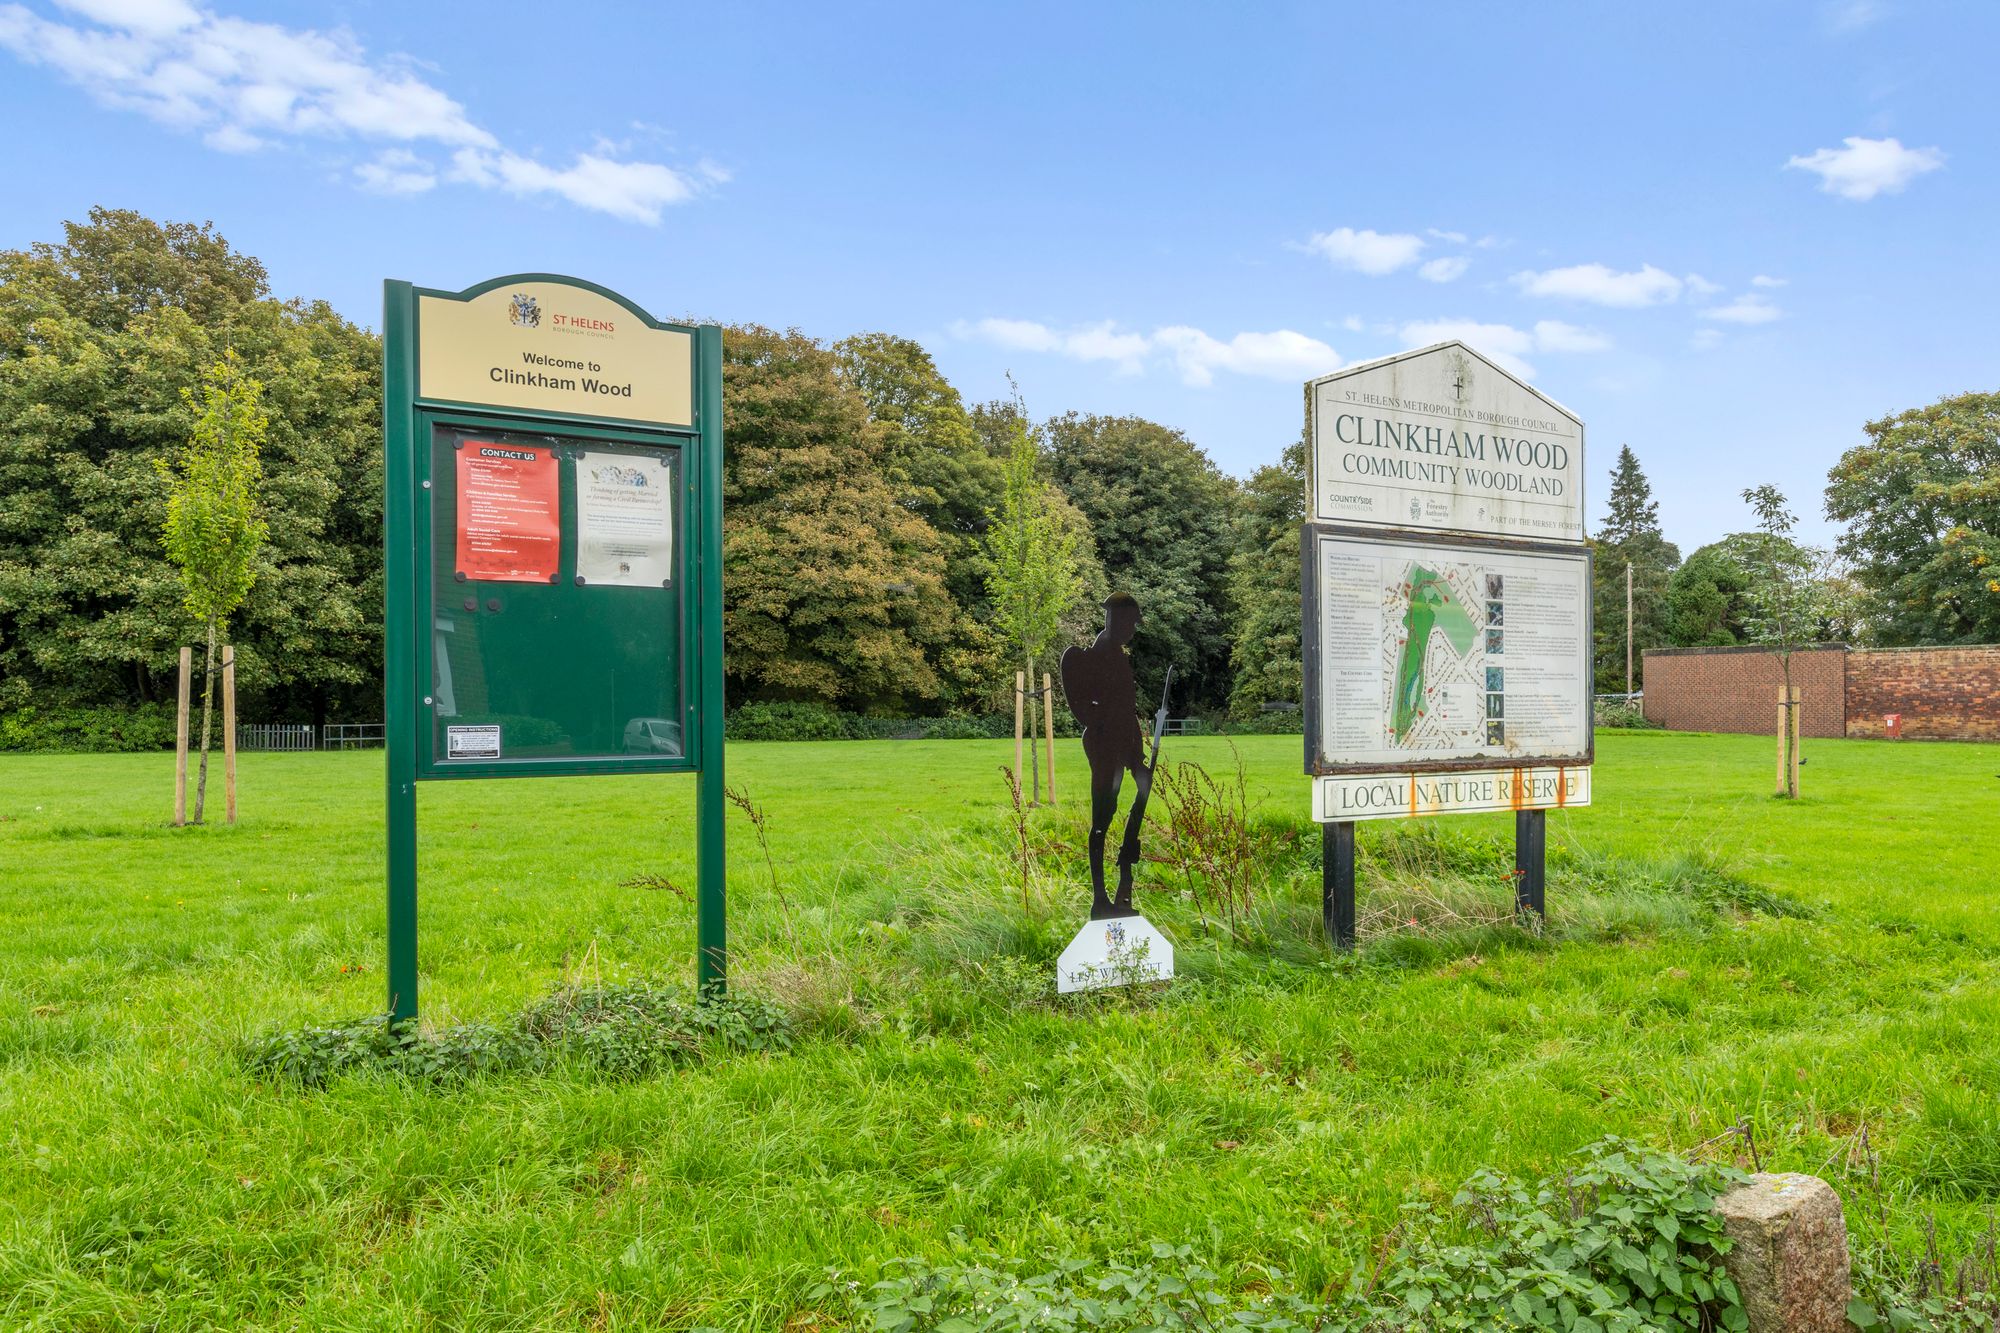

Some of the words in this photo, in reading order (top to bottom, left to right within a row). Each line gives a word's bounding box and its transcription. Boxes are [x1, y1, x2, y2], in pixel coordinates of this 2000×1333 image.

[553, 314, 567, 325] ST
[571, 317, 614, 332] HELENS
[552, 326, 584, 335] BOROUGH
[586, 331, 614, 340] COUNCIL
[523, 352, 584, 371] Welcome
[588, 360, 601, 373] to
[490, 367, 576, 391] Clinkham
[582, 378, 632, 398] Wood
[1363, 393, 1400, 408] HELENS
[1403, 400, 1474, 418] METROPOLITAN
[1477, 411, 1519, 427] BOROUGH
[1521, 418, 1559, 432] COUNCIL
[1336, 413, 1486, 462] CLINKHAM
[1492, 435, 1569, 471] WOOD
[481, 448, 521, 459] CONTACT
[524, 453, 535, 461] US
[1343, 453, 1461, 485] COMMUNITY
[1465, 468, 1563, 497] WOODLAND
[1329, 494, 1373, 505] COUNTRYSIDE
[1426, 503, 1448, 511] Forestry
[1491, 516, 1507, 524] PART
[1509, 517, 1517, 525] OF
[1519, 518, 1530, 526] THE
[1532, 519, 1557, 529] MERSEY
[1558, 522, 1580, 530] FOREST
[1342, 785, 1411, 809] LOCAL
[1416, 780, 1493, 805] NATURE
[1498, 777, 1575, 801] RESERVE
